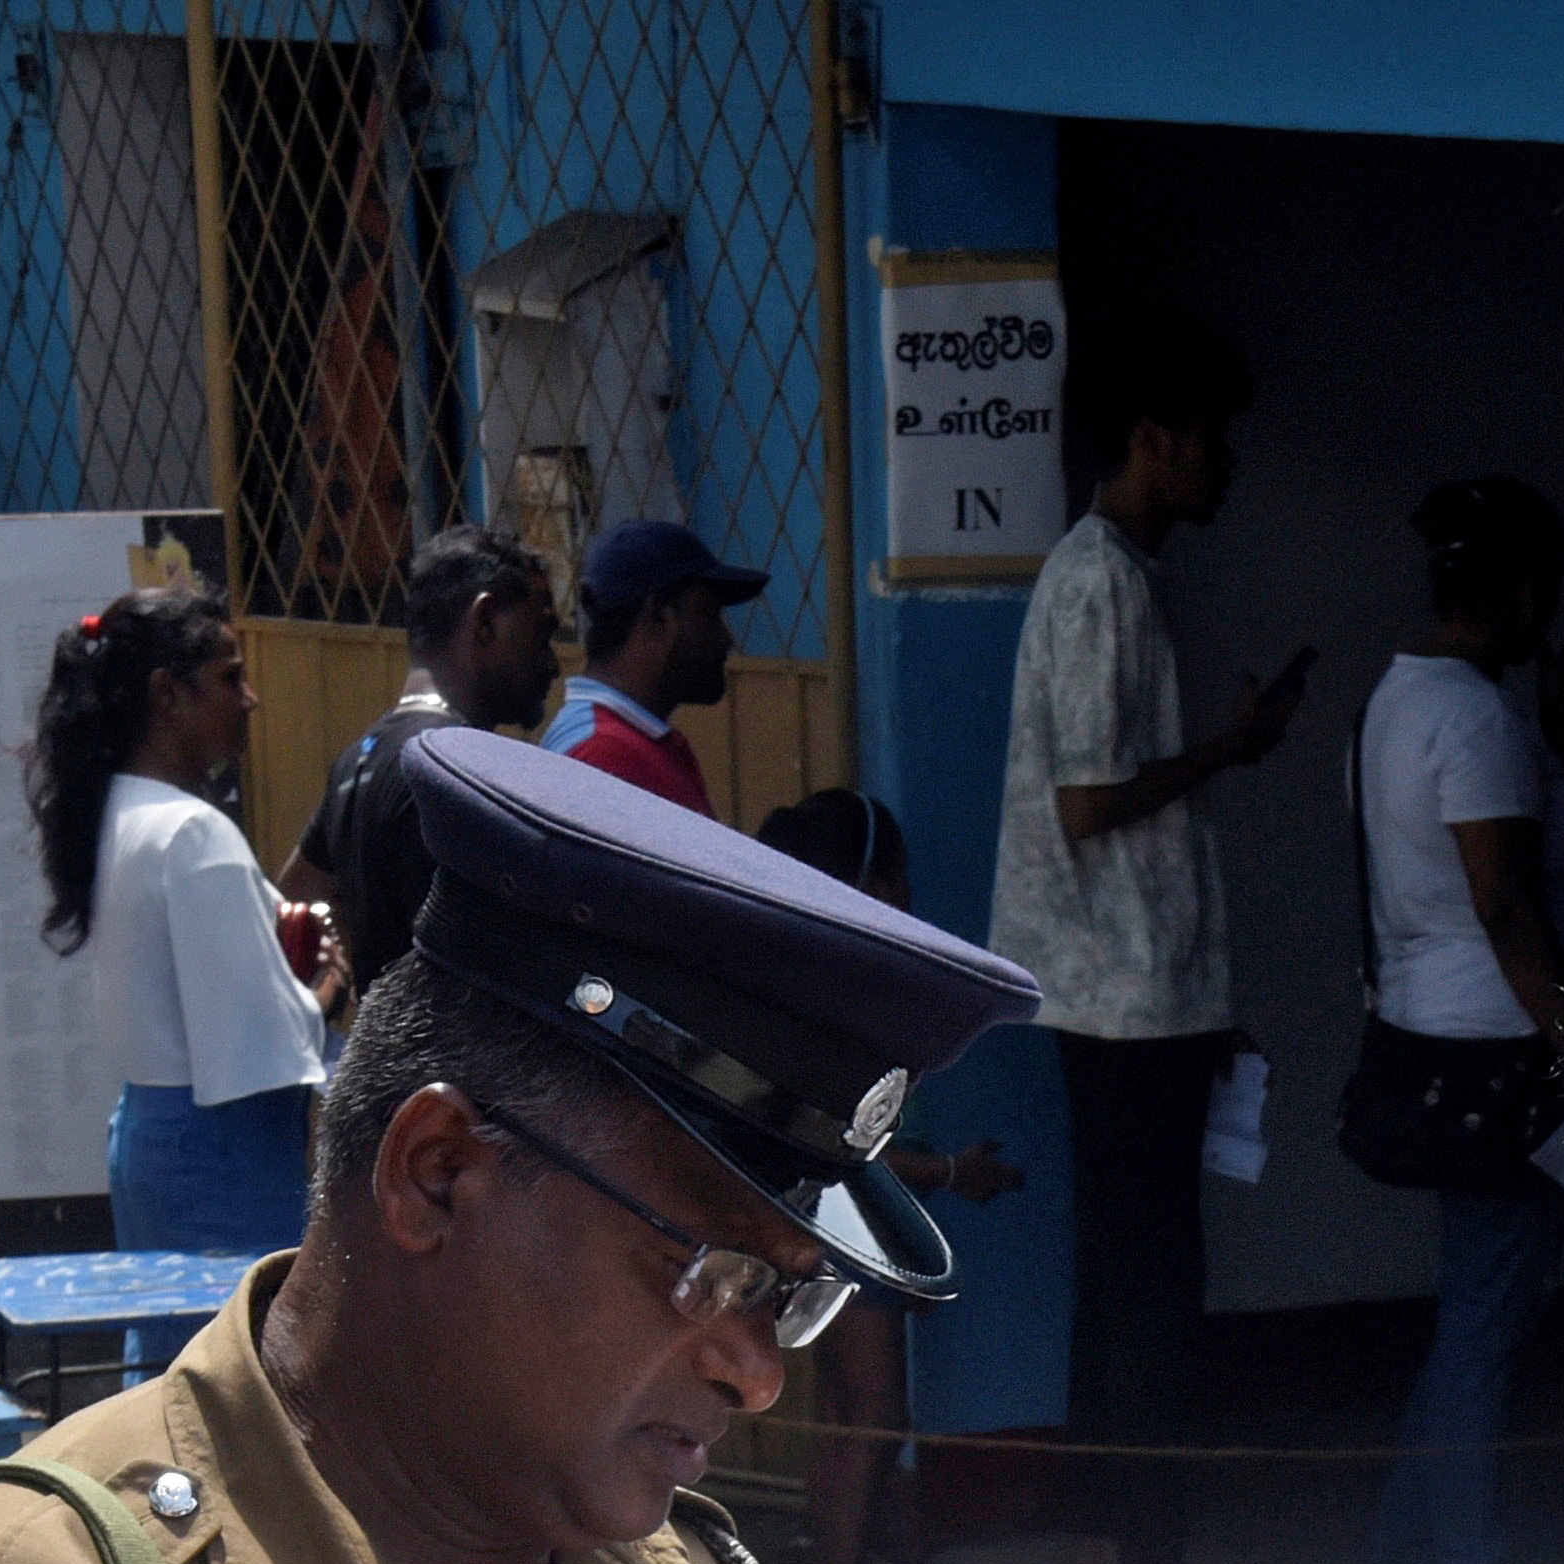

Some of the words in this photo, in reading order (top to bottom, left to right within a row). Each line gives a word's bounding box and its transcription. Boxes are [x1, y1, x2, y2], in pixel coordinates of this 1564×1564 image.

[895, 315, 1055, 373] ඇතුල්වීම
[895, 398, 1053, 440] உள்ளே
[955, 487, 1002, 531] IN
